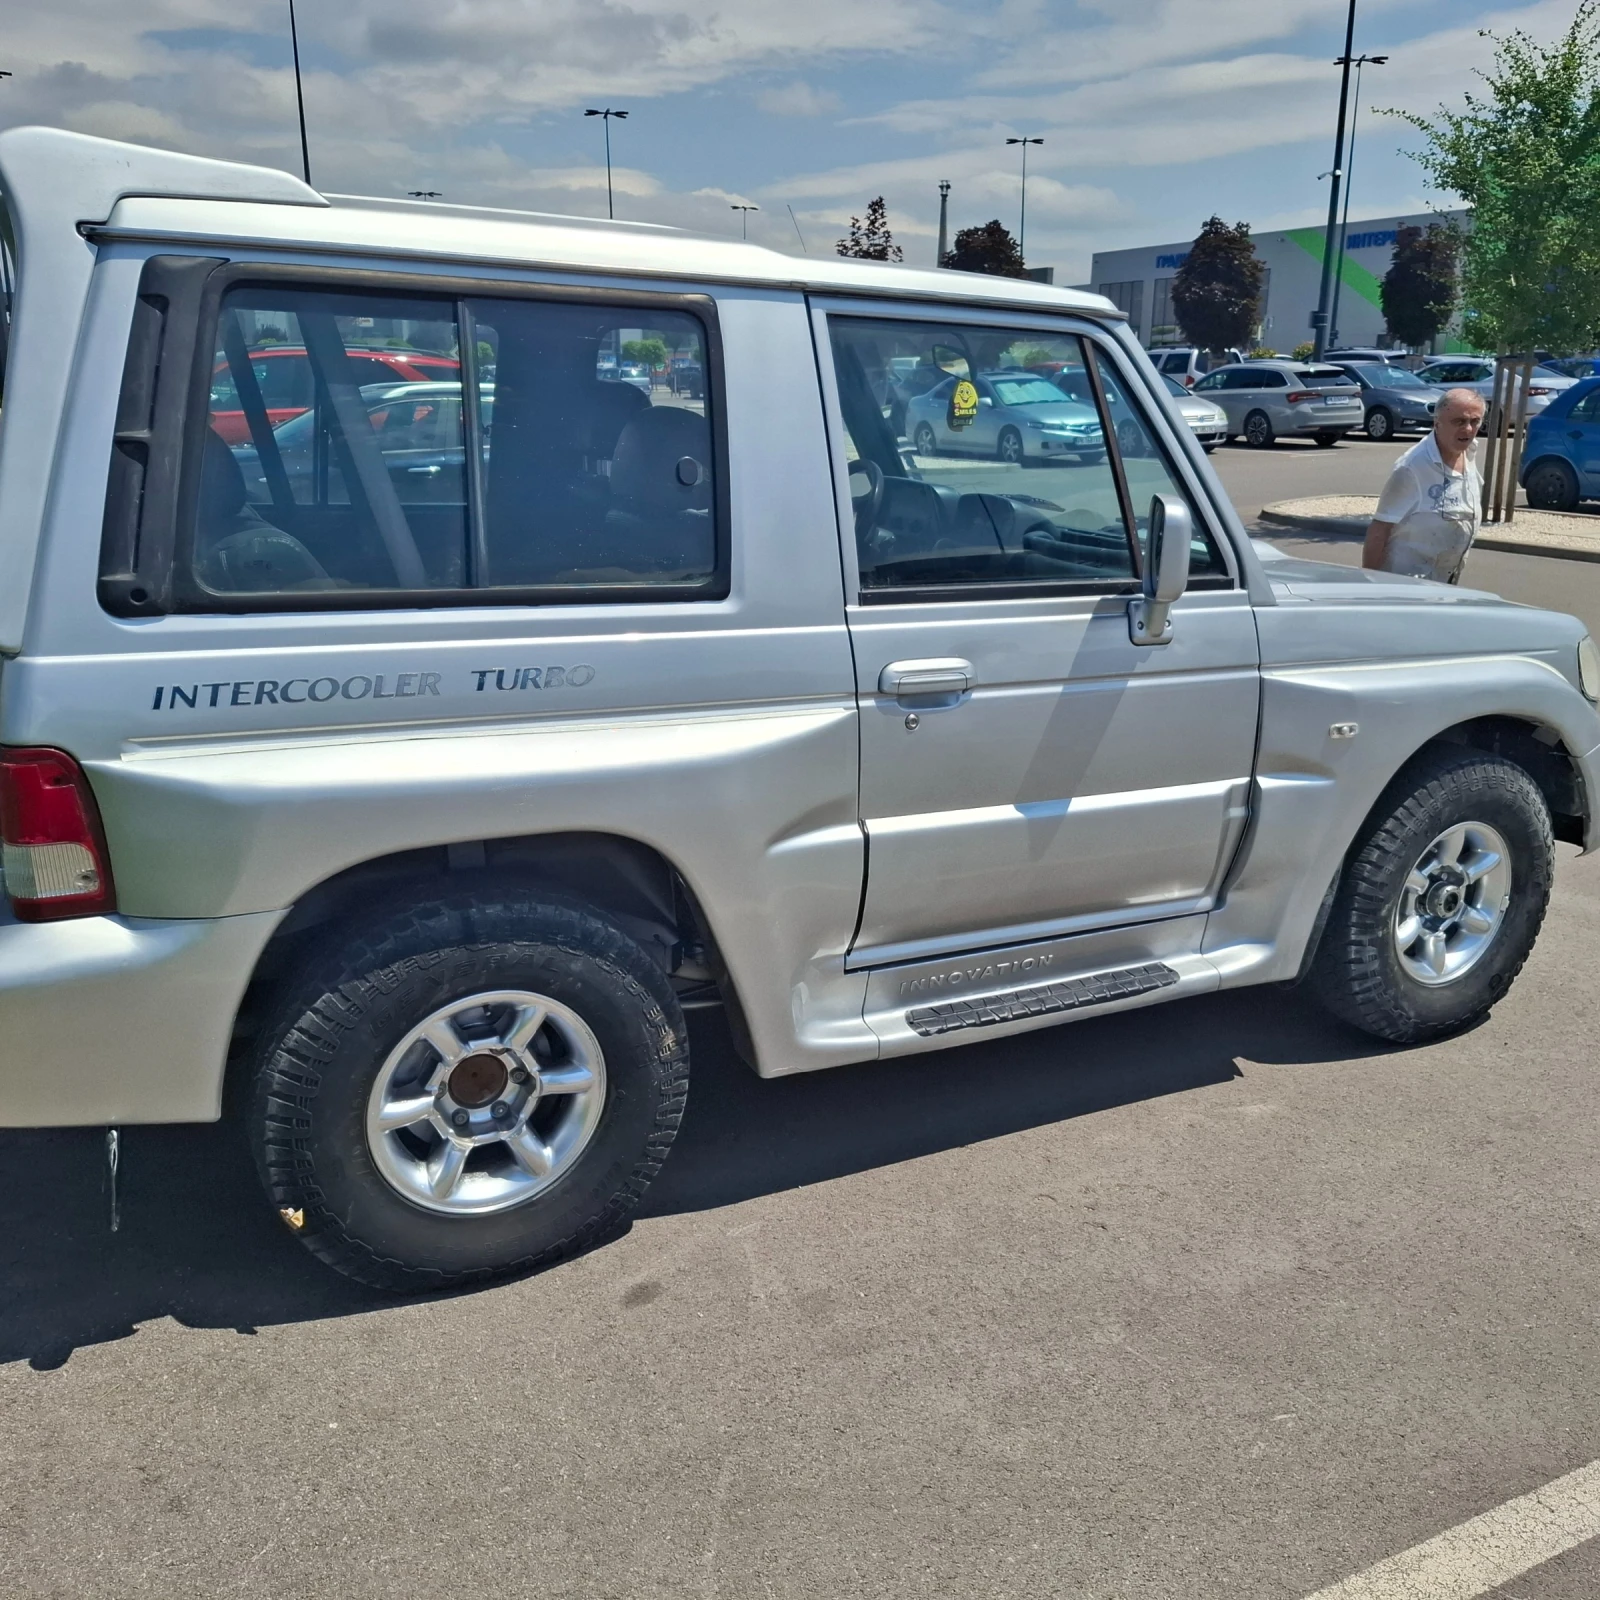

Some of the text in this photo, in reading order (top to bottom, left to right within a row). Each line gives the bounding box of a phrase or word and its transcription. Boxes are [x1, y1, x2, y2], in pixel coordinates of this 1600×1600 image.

[152, 664, 597, 710] INTERCOOLER TURBO
[900, 954, 1054, 995] INNOVATION
